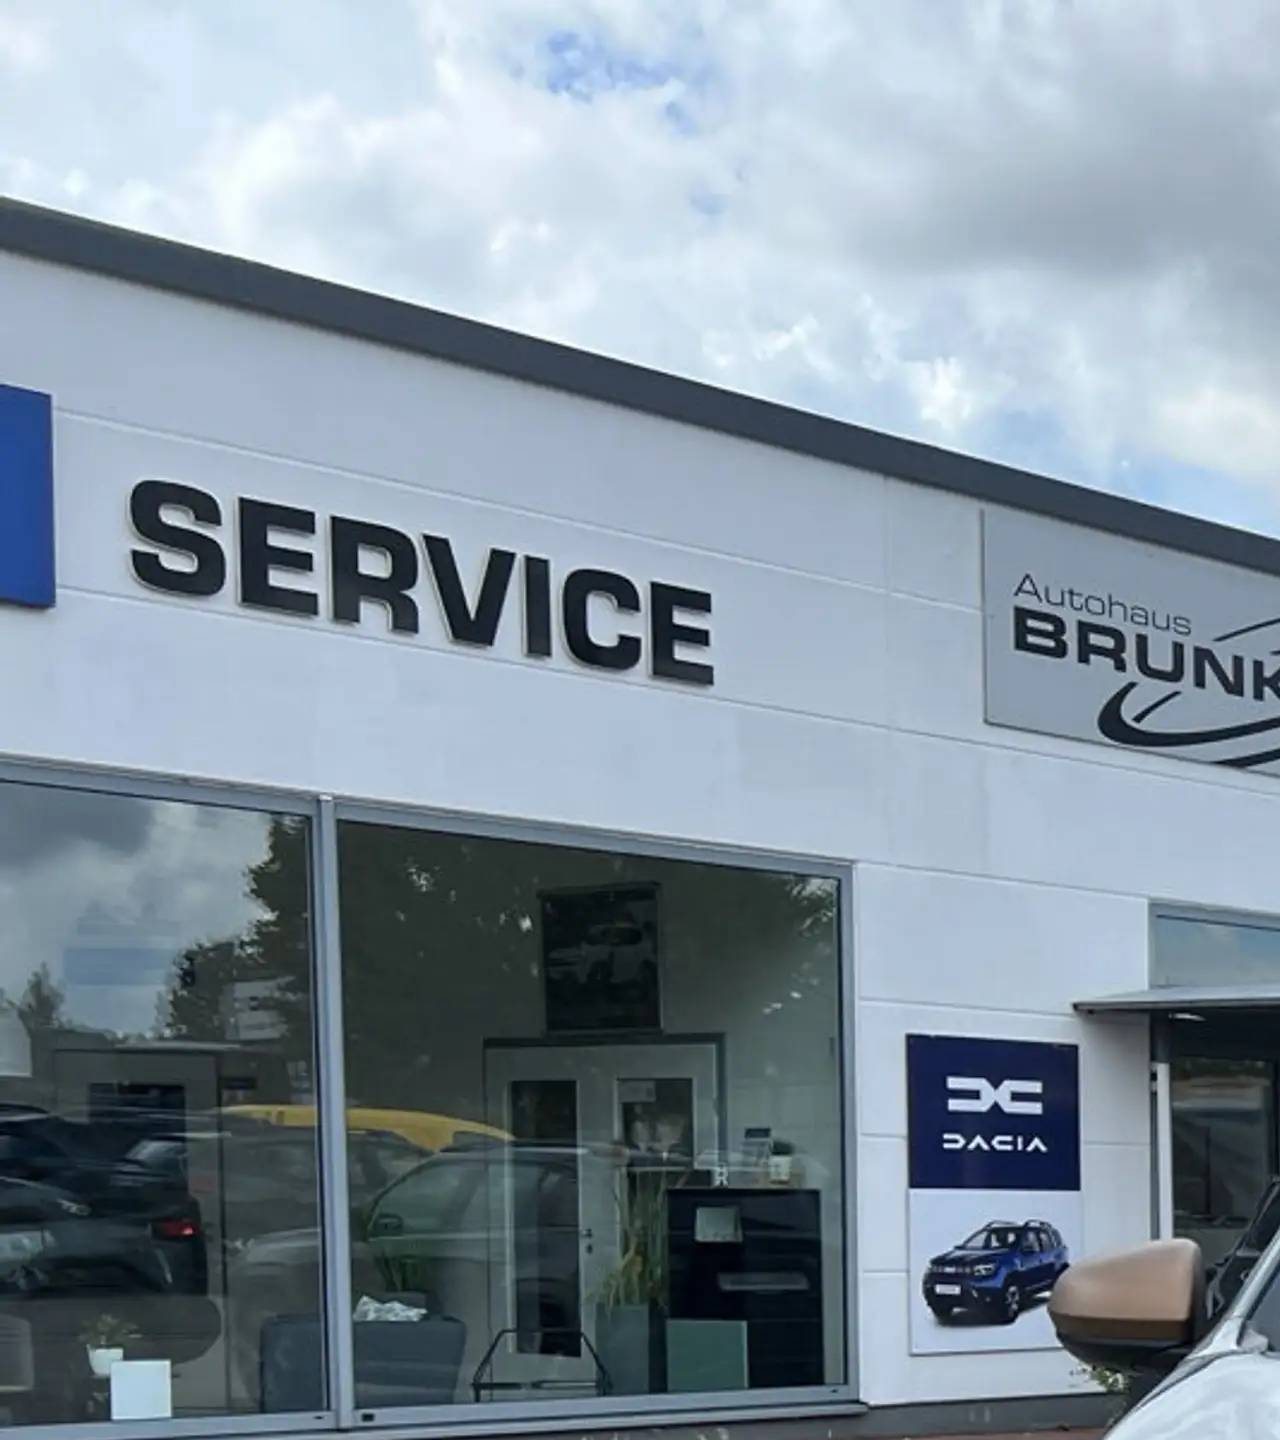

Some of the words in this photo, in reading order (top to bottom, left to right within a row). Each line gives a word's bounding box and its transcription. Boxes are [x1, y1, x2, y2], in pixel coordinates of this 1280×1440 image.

[128, 479, 715, 687] SERVICE
[1013, 572, 1192, 636] Autohaus
[942, 1132, 1048, 1153] DACIA
